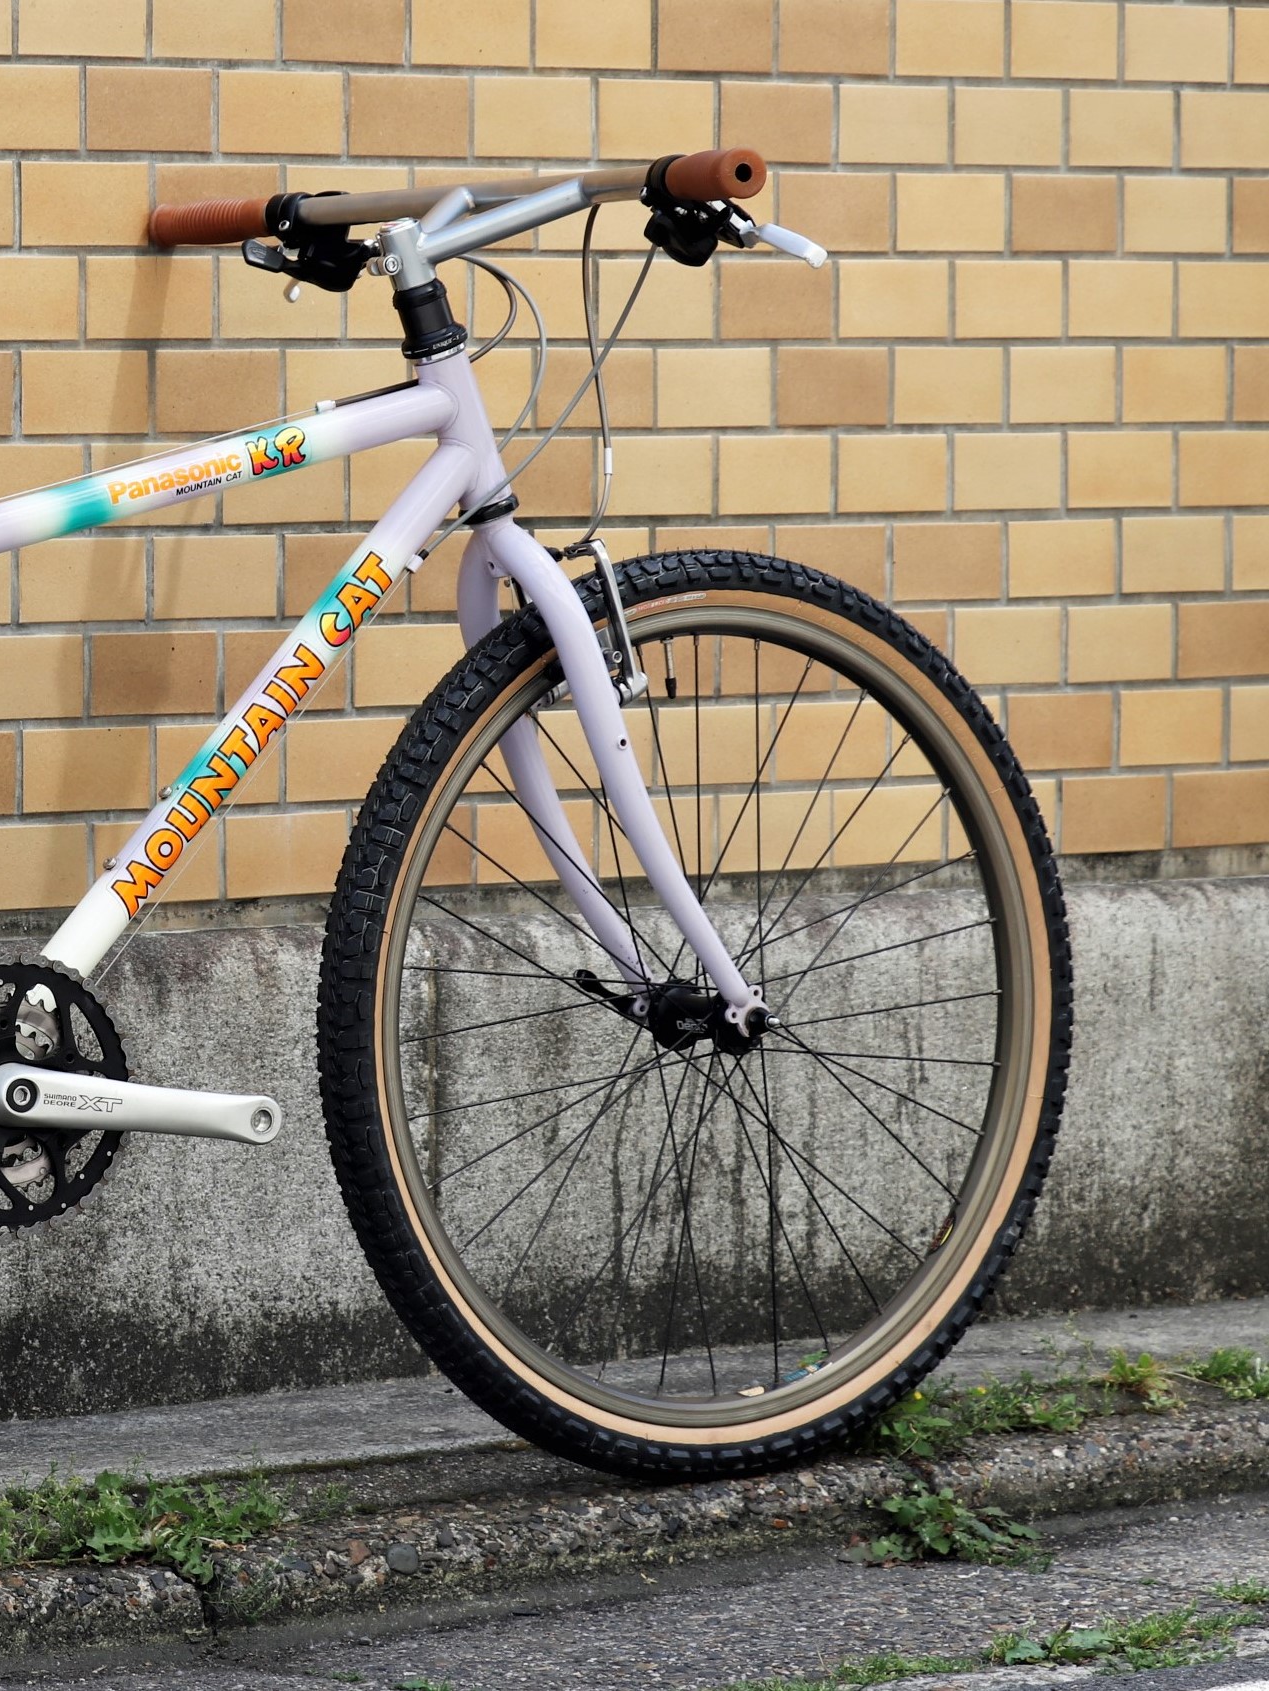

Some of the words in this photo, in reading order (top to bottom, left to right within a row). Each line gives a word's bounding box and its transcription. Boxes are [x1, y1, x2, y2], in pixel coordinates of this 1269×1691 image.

[107, 452, 243, 505] Panasonic
[246, 426, 307, 476] KR
[176, 478, 222, 496] MOUNTAIN
[225, 471, 243, 482] CAT
[111, 643, 326, 921] MOUNTAIN
[320, 550, 393, 648] CAT
[43, 1093, 77, 1102] SHIMANO
[43, 1099, 76, 1108] DEORE
[77, 1094, 123, 1113] XT
